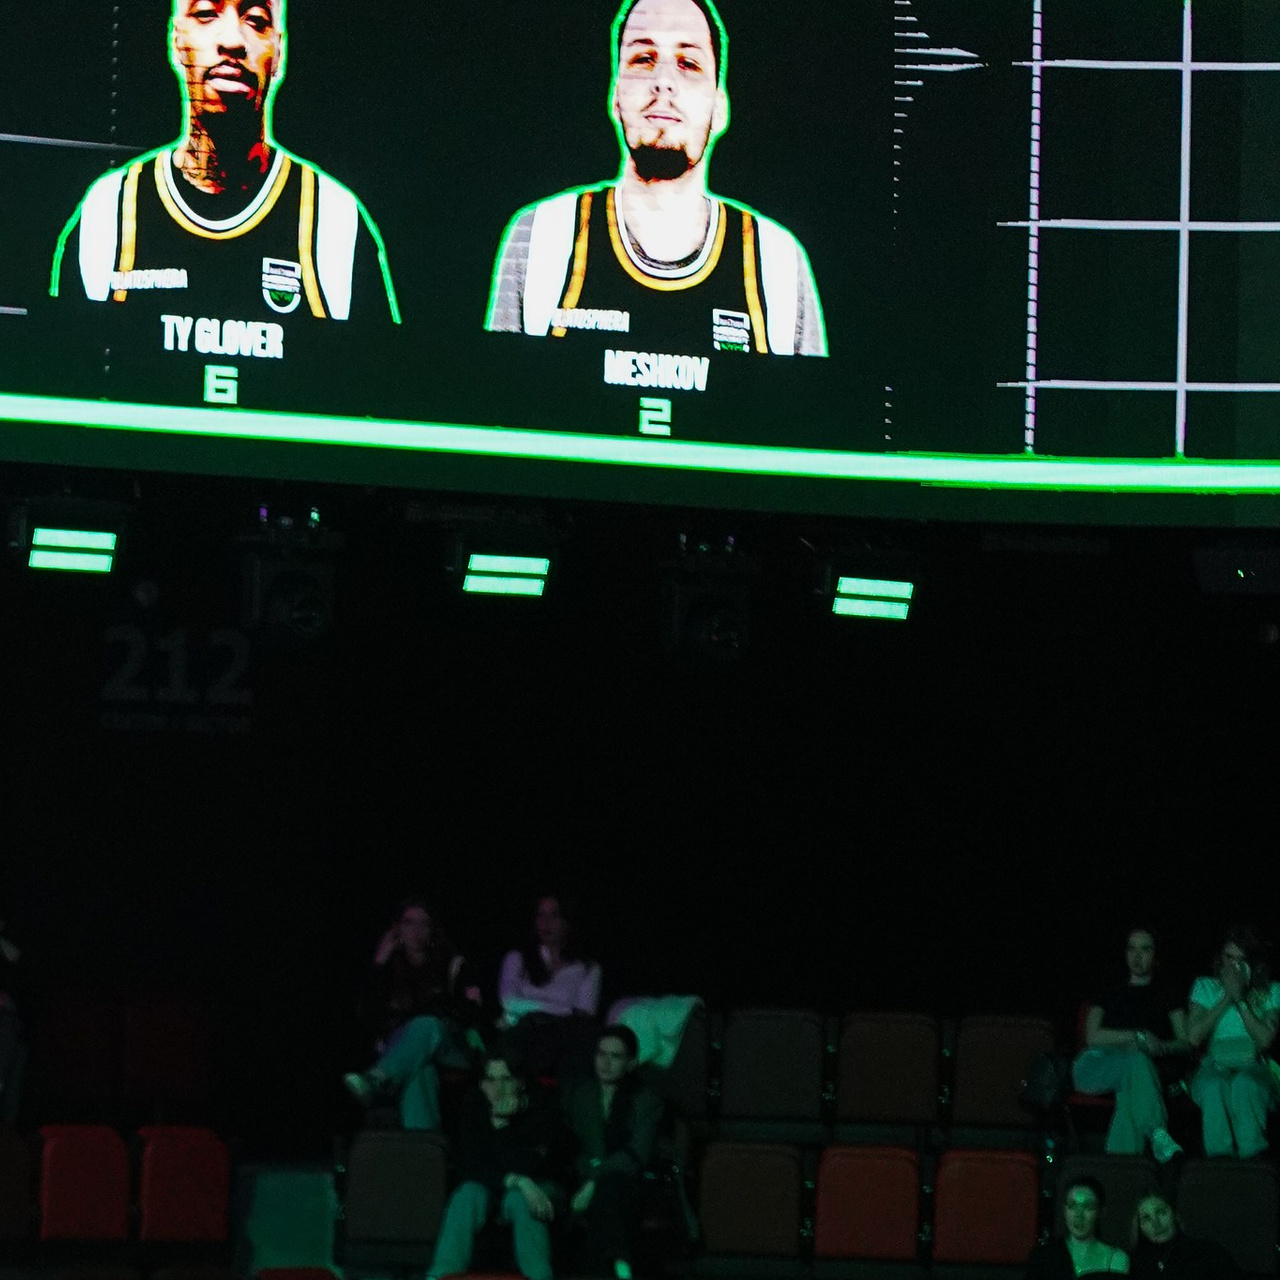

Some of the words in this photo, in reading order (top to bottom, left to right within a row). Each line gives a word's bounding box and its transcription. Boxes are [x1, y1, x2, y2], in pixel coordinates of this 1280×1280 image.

[160, 314, 194, 351] TY
[195, 317, 284, 359] GLOVER
[203, 364, 239, 404] 6
[604, 349, 710, 391] MESHKOV
[638, 396, 672, 436] 2
[100, 624, 251, 705] 212
